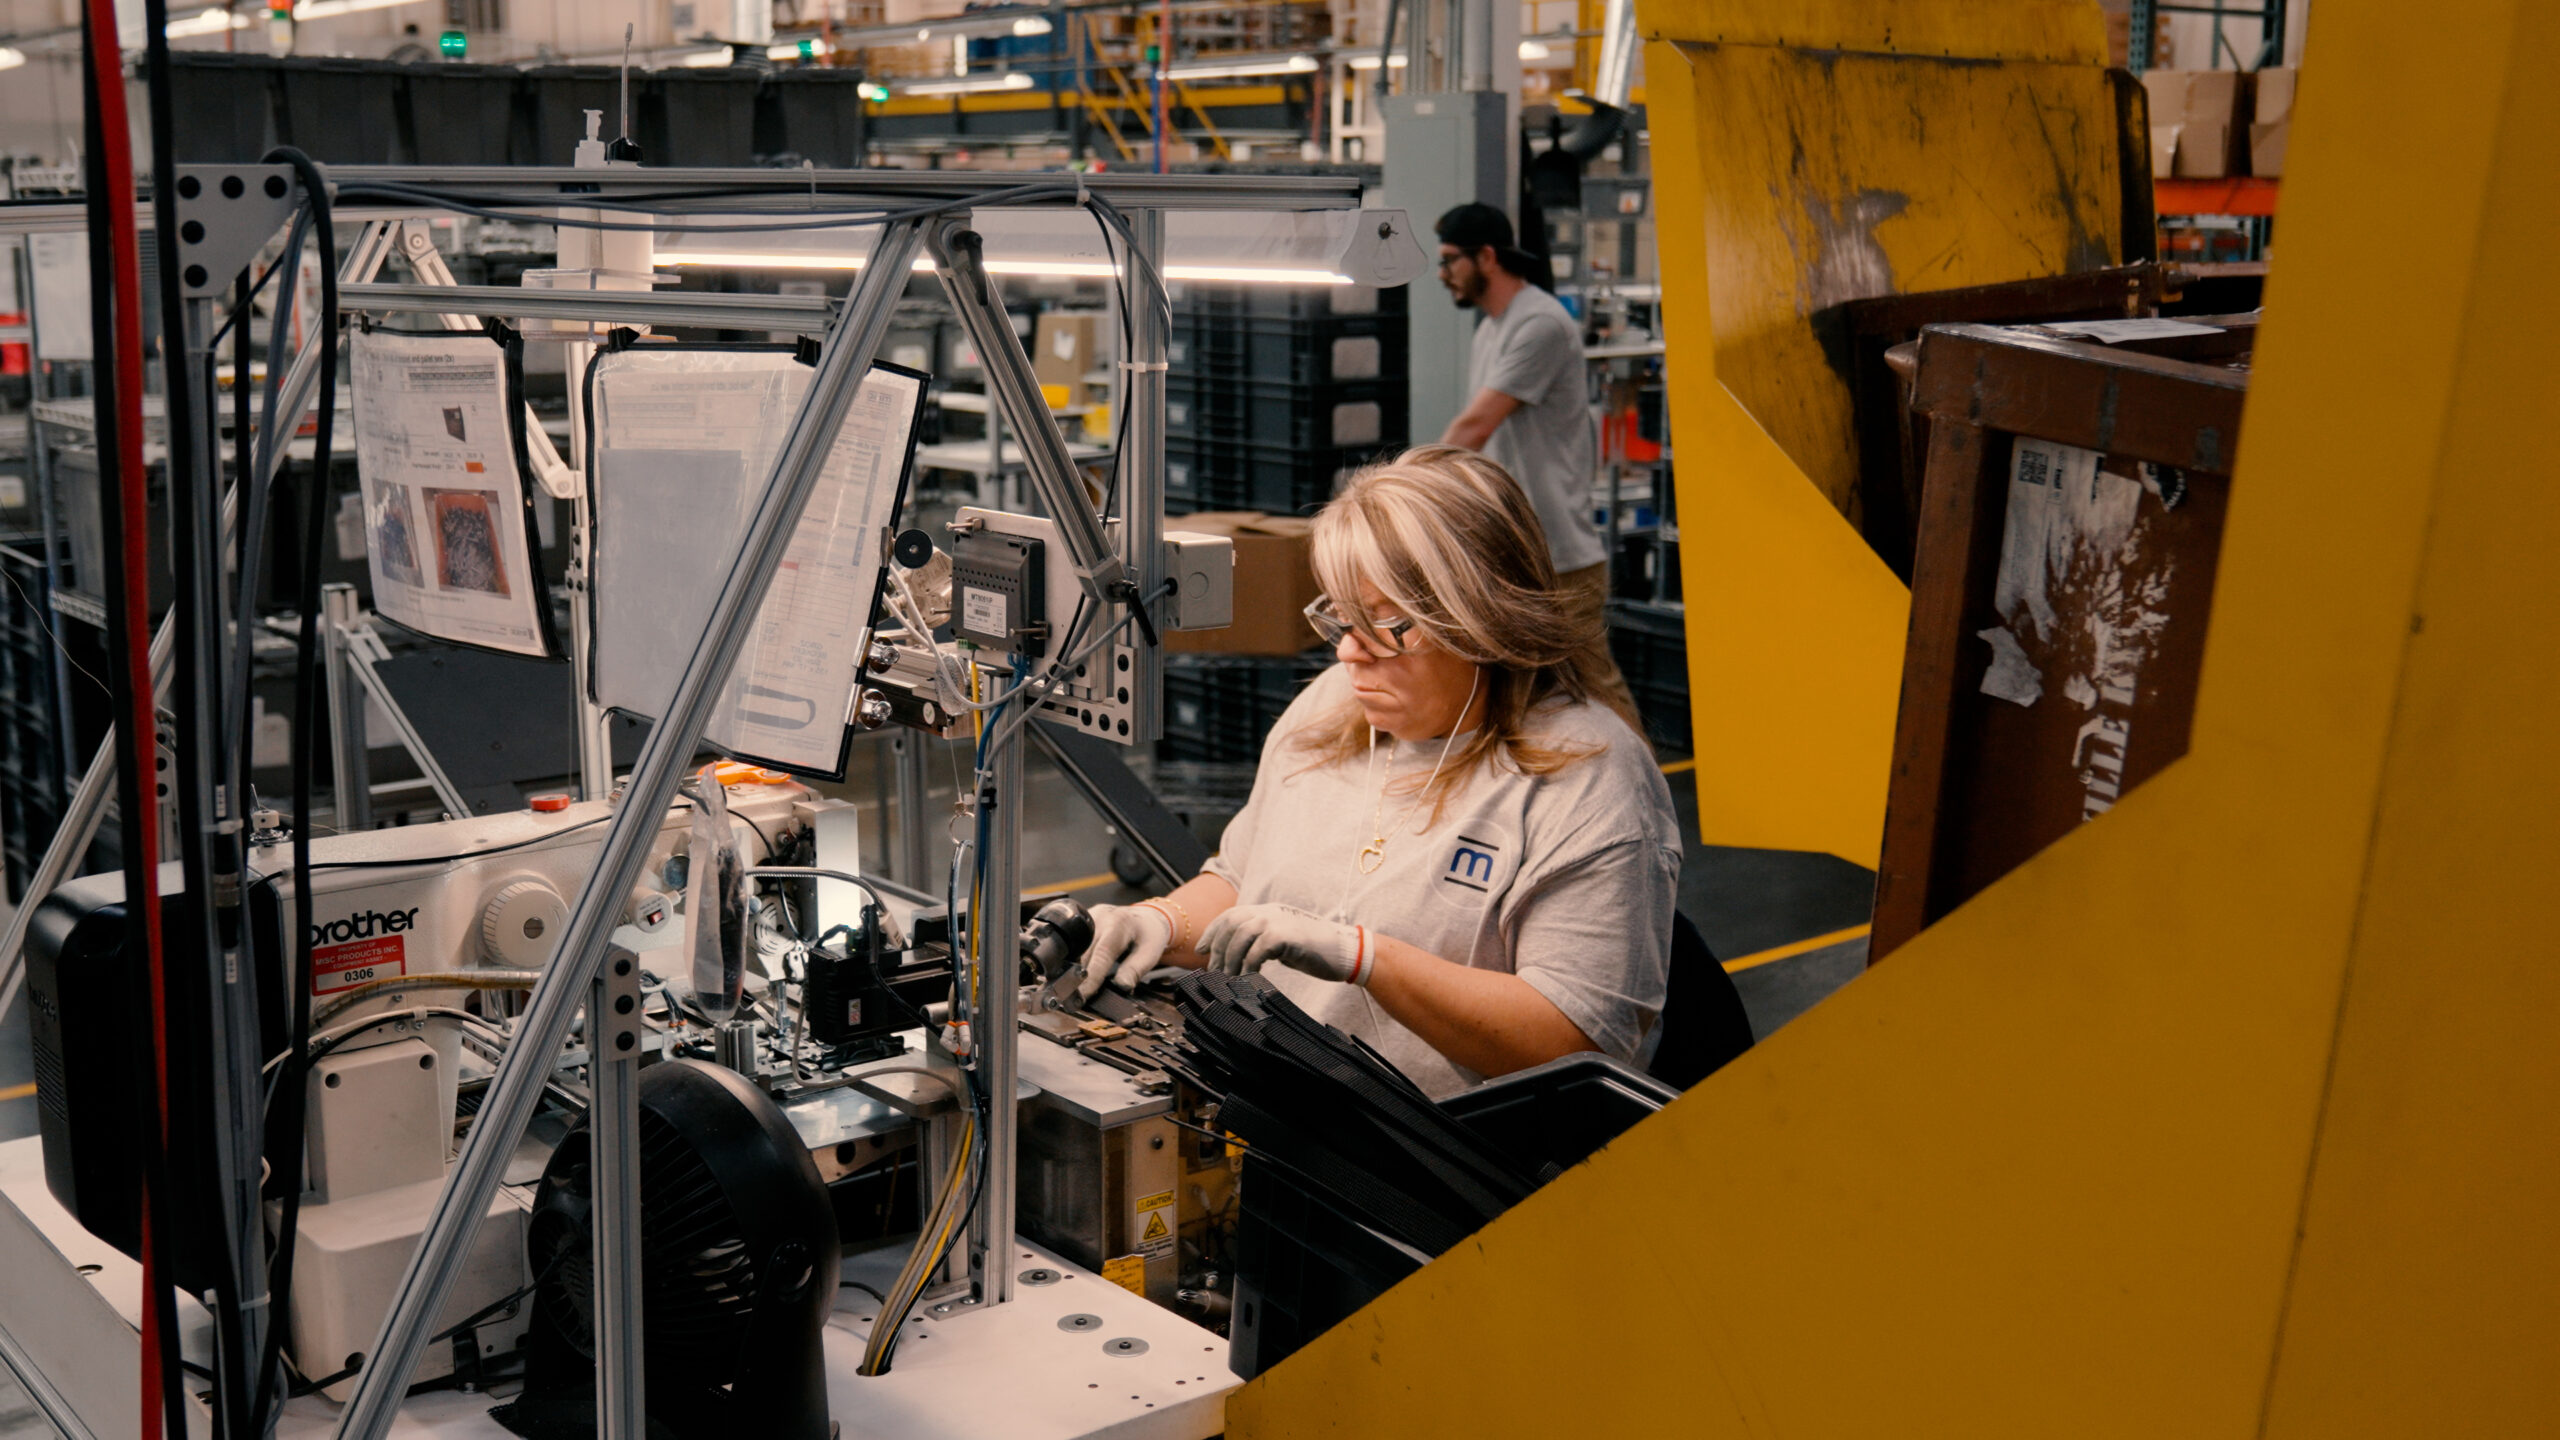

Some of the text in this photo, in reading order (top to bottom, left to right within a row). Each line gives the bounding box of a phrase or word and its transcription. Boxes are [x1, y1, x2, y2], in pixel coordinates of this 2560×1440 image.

[1450, 847, 1493, 882] m
[338, 943, 367, 952] PROPERTY
[315, 956, 336, 965] MISC
[338, 948, 381, 961] PRODUCTS
[333, 958, 364, 969] EQUIPMENT
[344, 968, 374, 982] 0306
[1146, 1195, 1172, 1207] CAUTION
